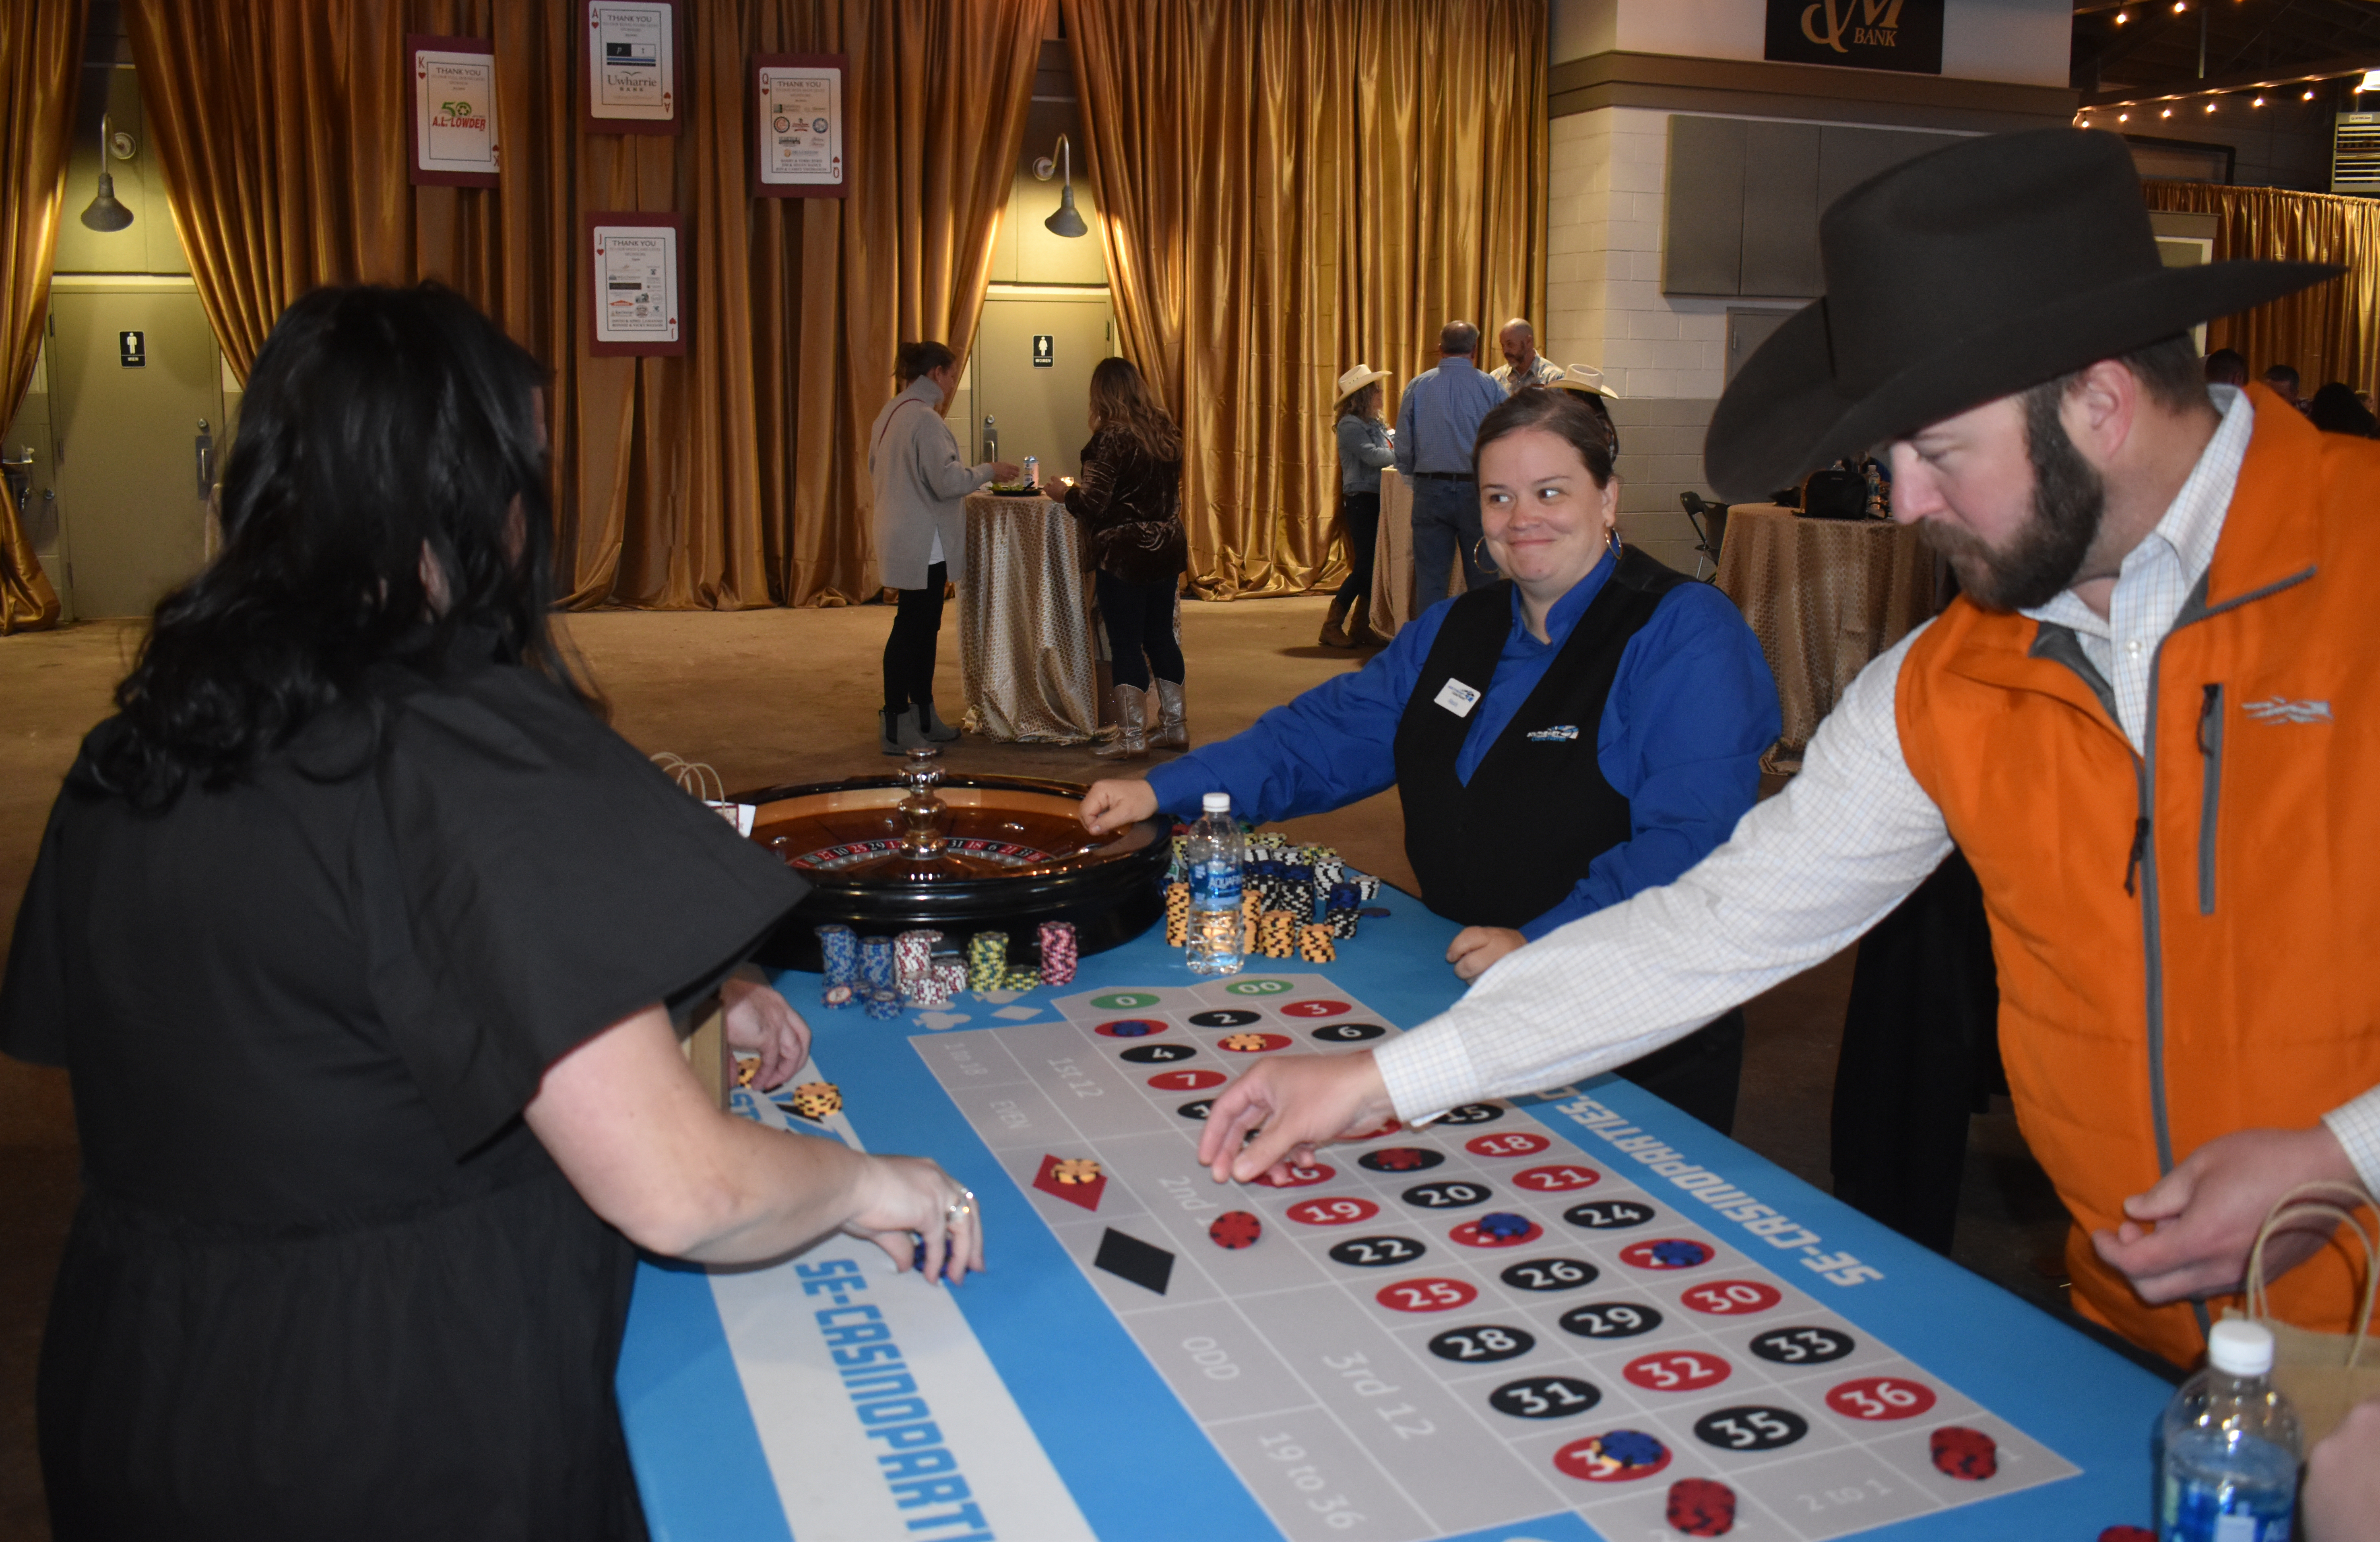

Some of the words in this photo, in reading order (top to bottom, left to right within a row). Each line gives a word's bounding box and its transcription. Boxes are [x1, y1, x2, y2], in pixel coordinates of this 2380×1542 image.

[592, 7, 598, 18] A
[1854, 28, 1897, 47] BANK
[419, 56, 425, 68] K
[608, 75, 657, 86] Uwharrie
[762, 73, 768, 85] Q
[665, 103, 670, 113] A
[451, 117, 486, 131] LOWDER
[599, 234, 601, 245] J
[833, 847, 849, 856] 10
[852, 845, 867, 853] 25
[868, 841, 886, 850] 29
[951, 840, 963, 848] 31
[968, 841, 981, 849] 18
[1239, 981, 1282, 994] 00
[1115, 996, 1137, 1006] 0
[1305, 1004, 1327, 1014] 3
[1214, 1014, 1237, 1024] 2
[1339, 1027, 1361, 1038] 6
[1153, 1048, 1175, 1059] 4
[1049, 1058, 1083, 1078] 1st
[1069, 1080, 1104, 1099] 12
[1176, 1074, 1196, 1085] 7
[1481, 1136, 1535, 1154] 18
[1530, 1169, 1591, 1188] 21
[1158, 1176, 1218, 1210] 2nd
[1417, 1185, 1476, 1205] 20
[1304, 1202, 1362, 1222] 19
[1577, 1205, 1641, 1226] 24
[1348, 1239, 1413, 1263] 22
[1517, 1262, 1583, 1287] 26
[1395, 1282, 1462, 1308] 25
[1694, 1285, 1762, 1312] 30
[1574, 1307, 1643, 1335] 29
[1445, 1328, 1517, 1358] 28
[1765, 1329, 1838, 1361] 33
[1181, 1336, 1240, 1381] ODD
[1638, 1356, 1715, 1387] 32
[1323, 1350, 1402, 1397] 3rd
[1375, 1402, 1436, 1440] 12
[1507, 1382, 1586, 1415] 31
[1841, 1382, 1917, 1417] 36
[1710, 1411, 1790, 1447] 35
[1259, 1431, 1307, 1462] 19
[1287, 1464, 1325, 1492] to
[1307, 1493, 1365, 1529] 36
[1797, 1493, 1824, 1512] 2
[1825, 1486, 1864, 1505] to
[1866, 1479, 1893, 1496] 1
